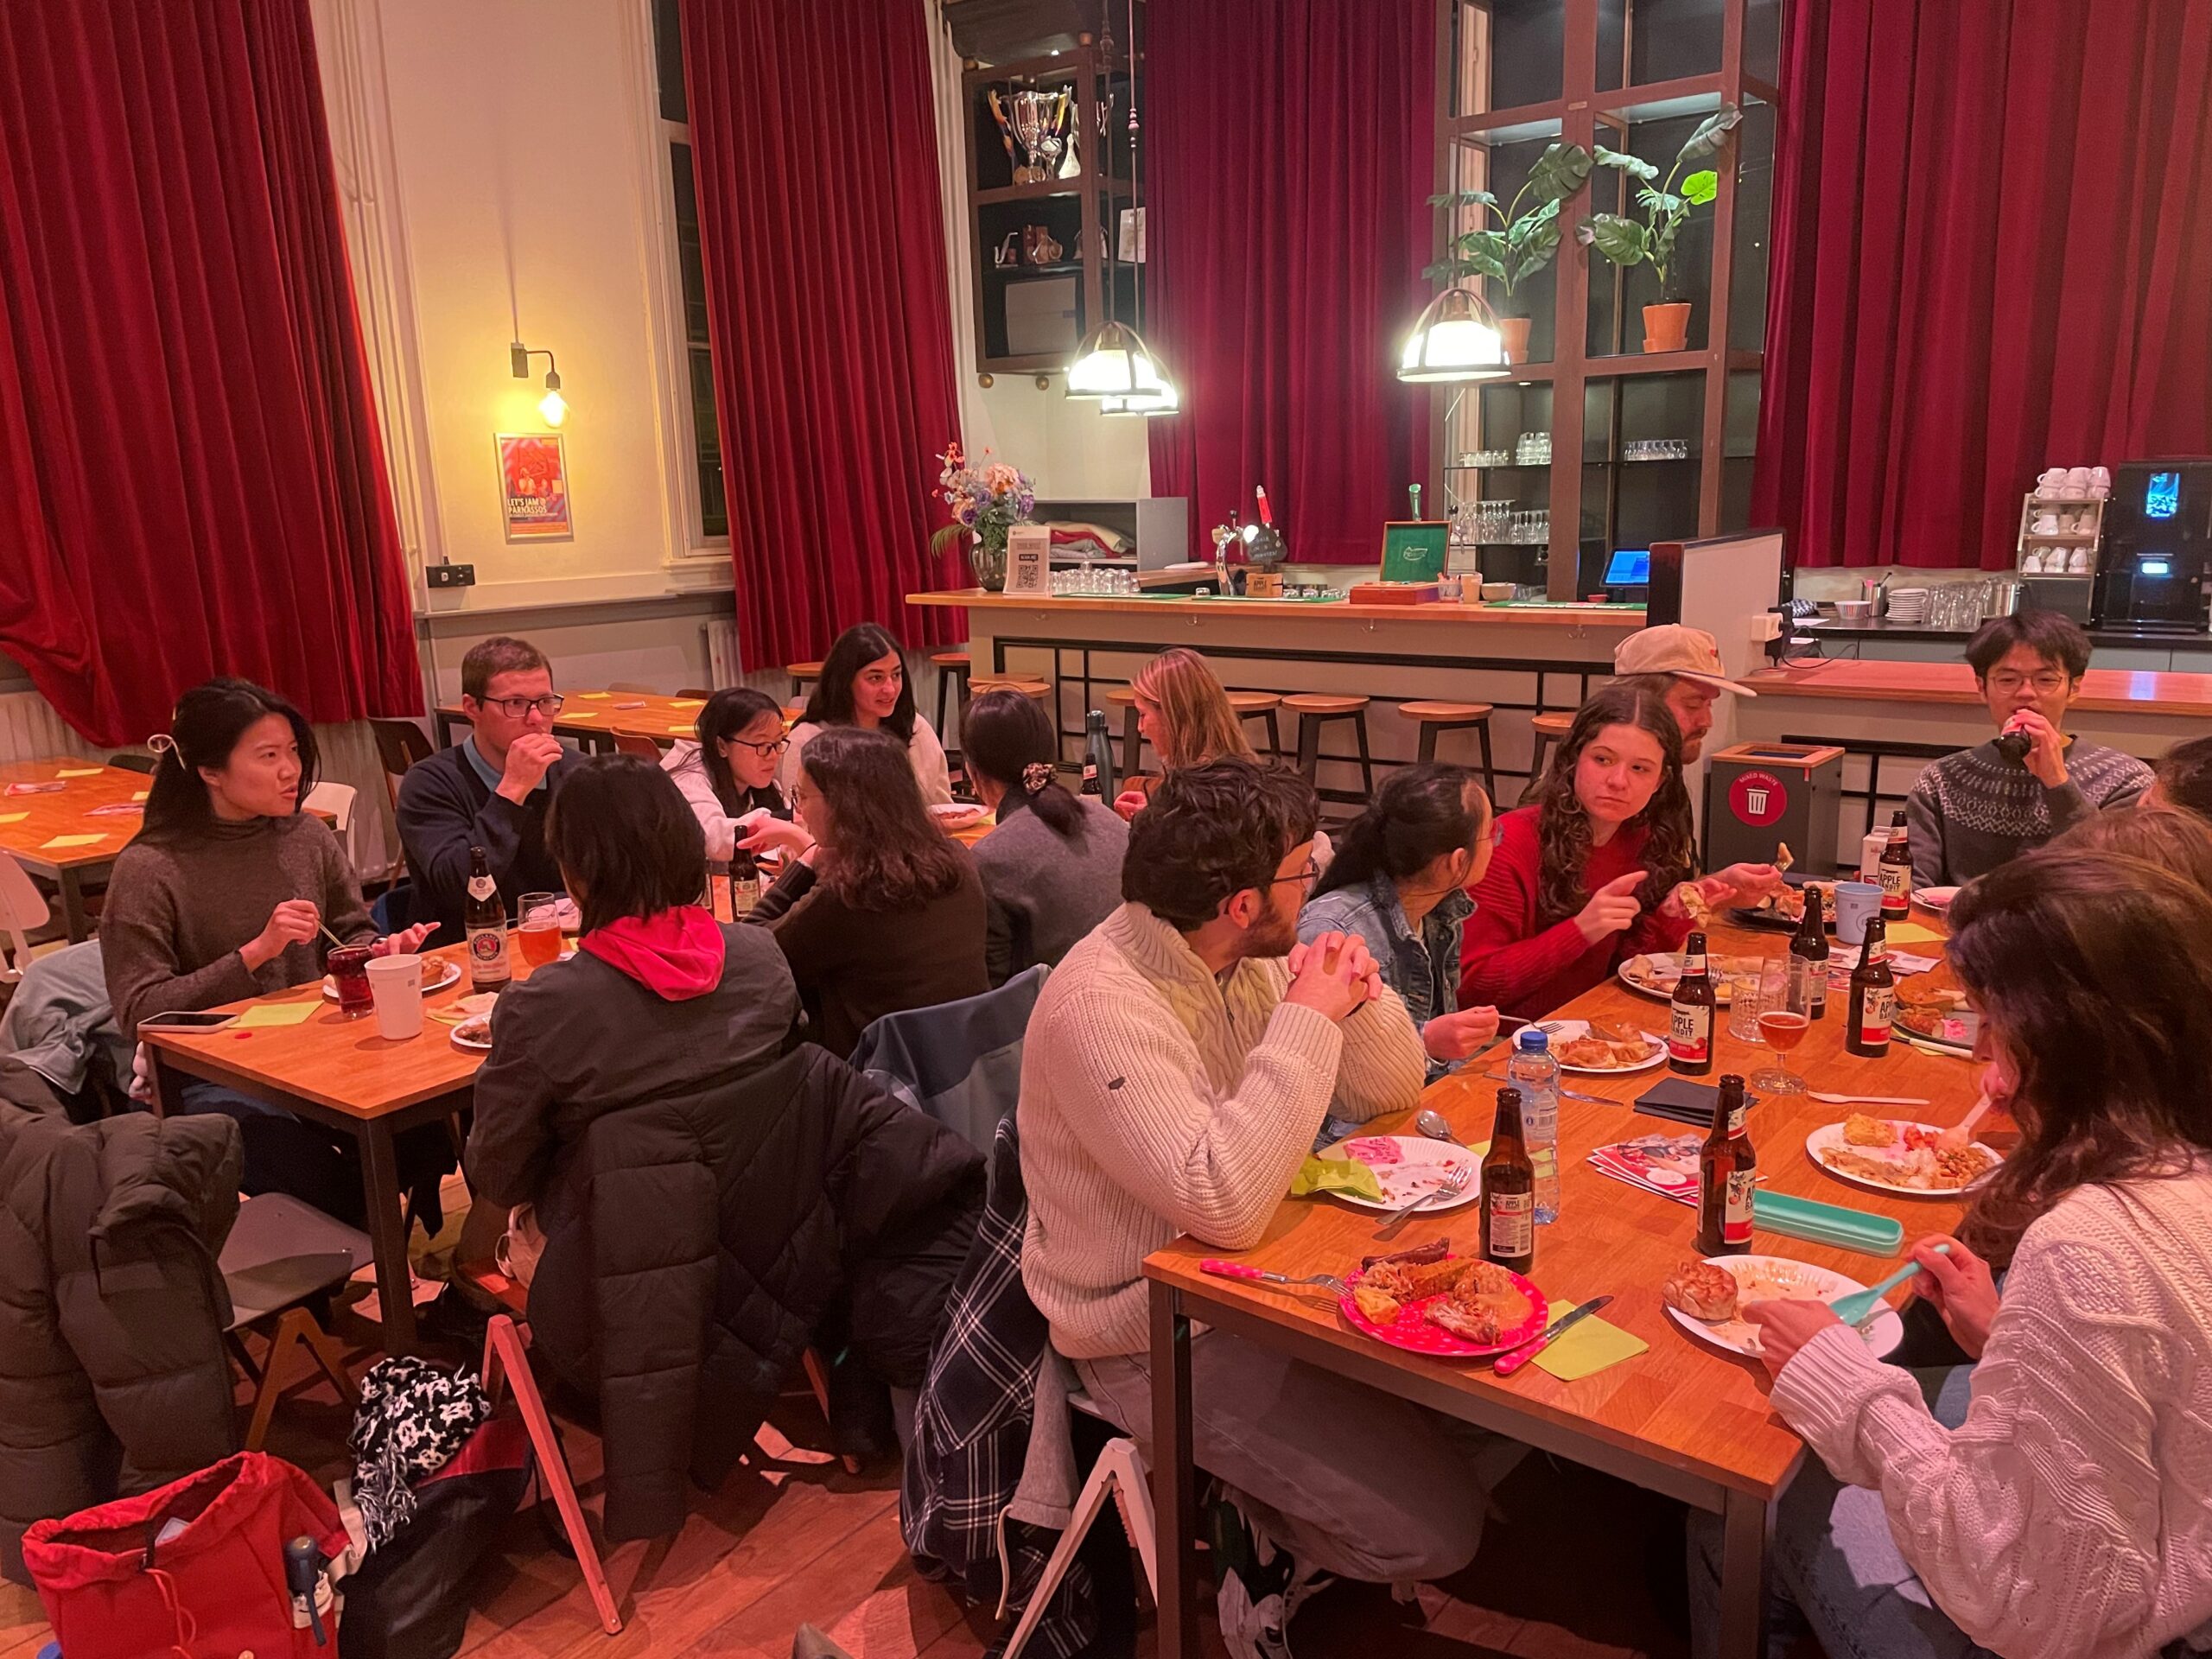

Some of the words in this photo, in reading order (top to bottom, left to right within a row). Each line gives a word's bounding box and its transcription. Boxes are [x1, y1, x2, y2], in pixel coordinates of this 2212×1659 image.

[508, 505, 548, 514] PARNASSOS
[1739, 772, 1758, 783] MIXED
[1758, 772, 1778, 786] WASTE
[1880, 873, 1901, 885] APPLE
[1672, 1024, 1694, 1037] NDIT
